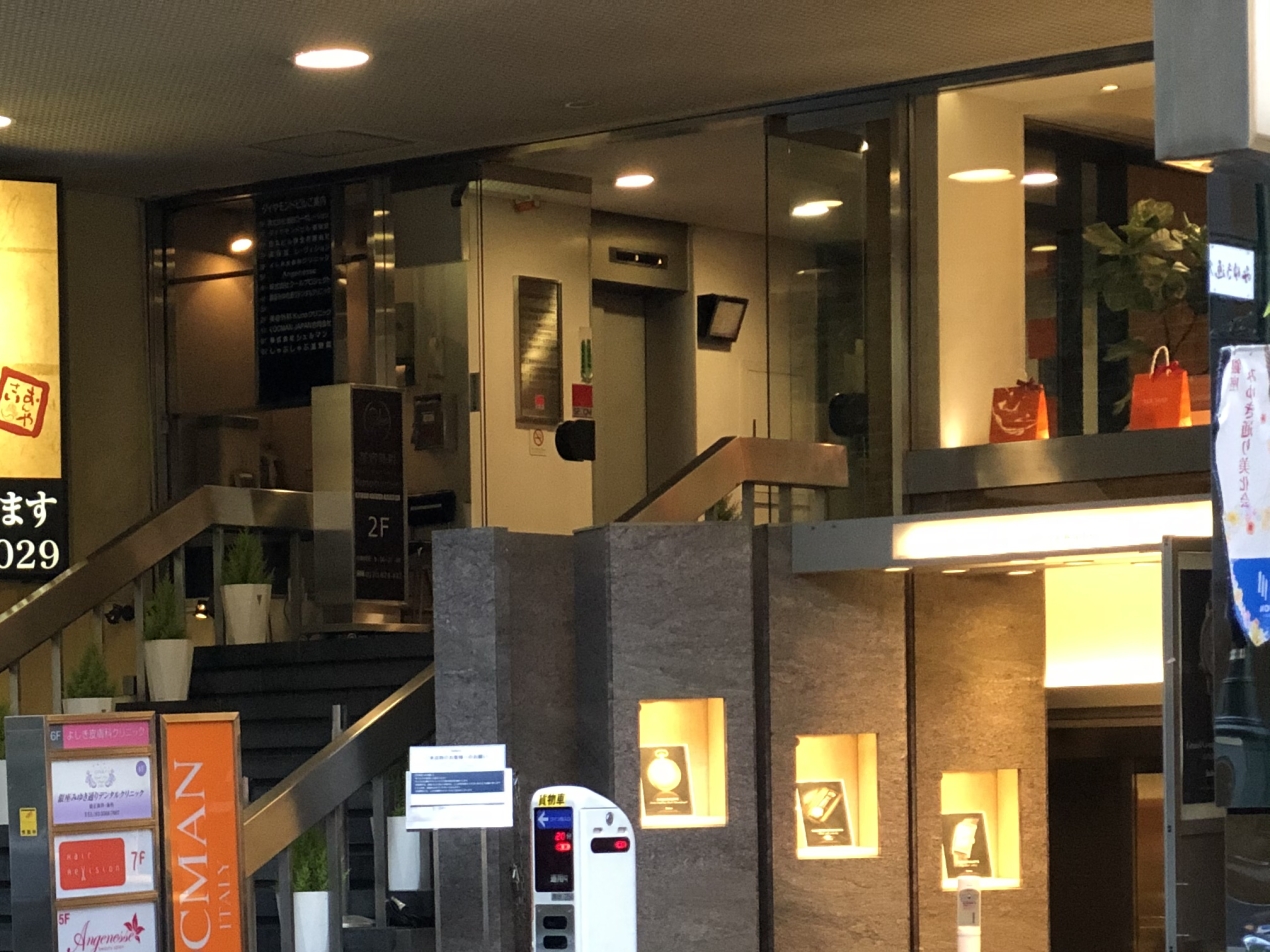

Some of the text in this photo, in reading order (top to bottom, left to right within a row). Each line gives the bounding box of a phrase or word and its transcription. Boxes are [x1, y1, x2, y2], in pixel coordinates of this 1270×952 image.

[367, 516, 390, 537] 2F
[50, 730, 62, 742] 6F
[538, 793, 565, 806] 貨物車
[130, 851, 145, 871] 7F
[58, 913, 70, 925] 5F
